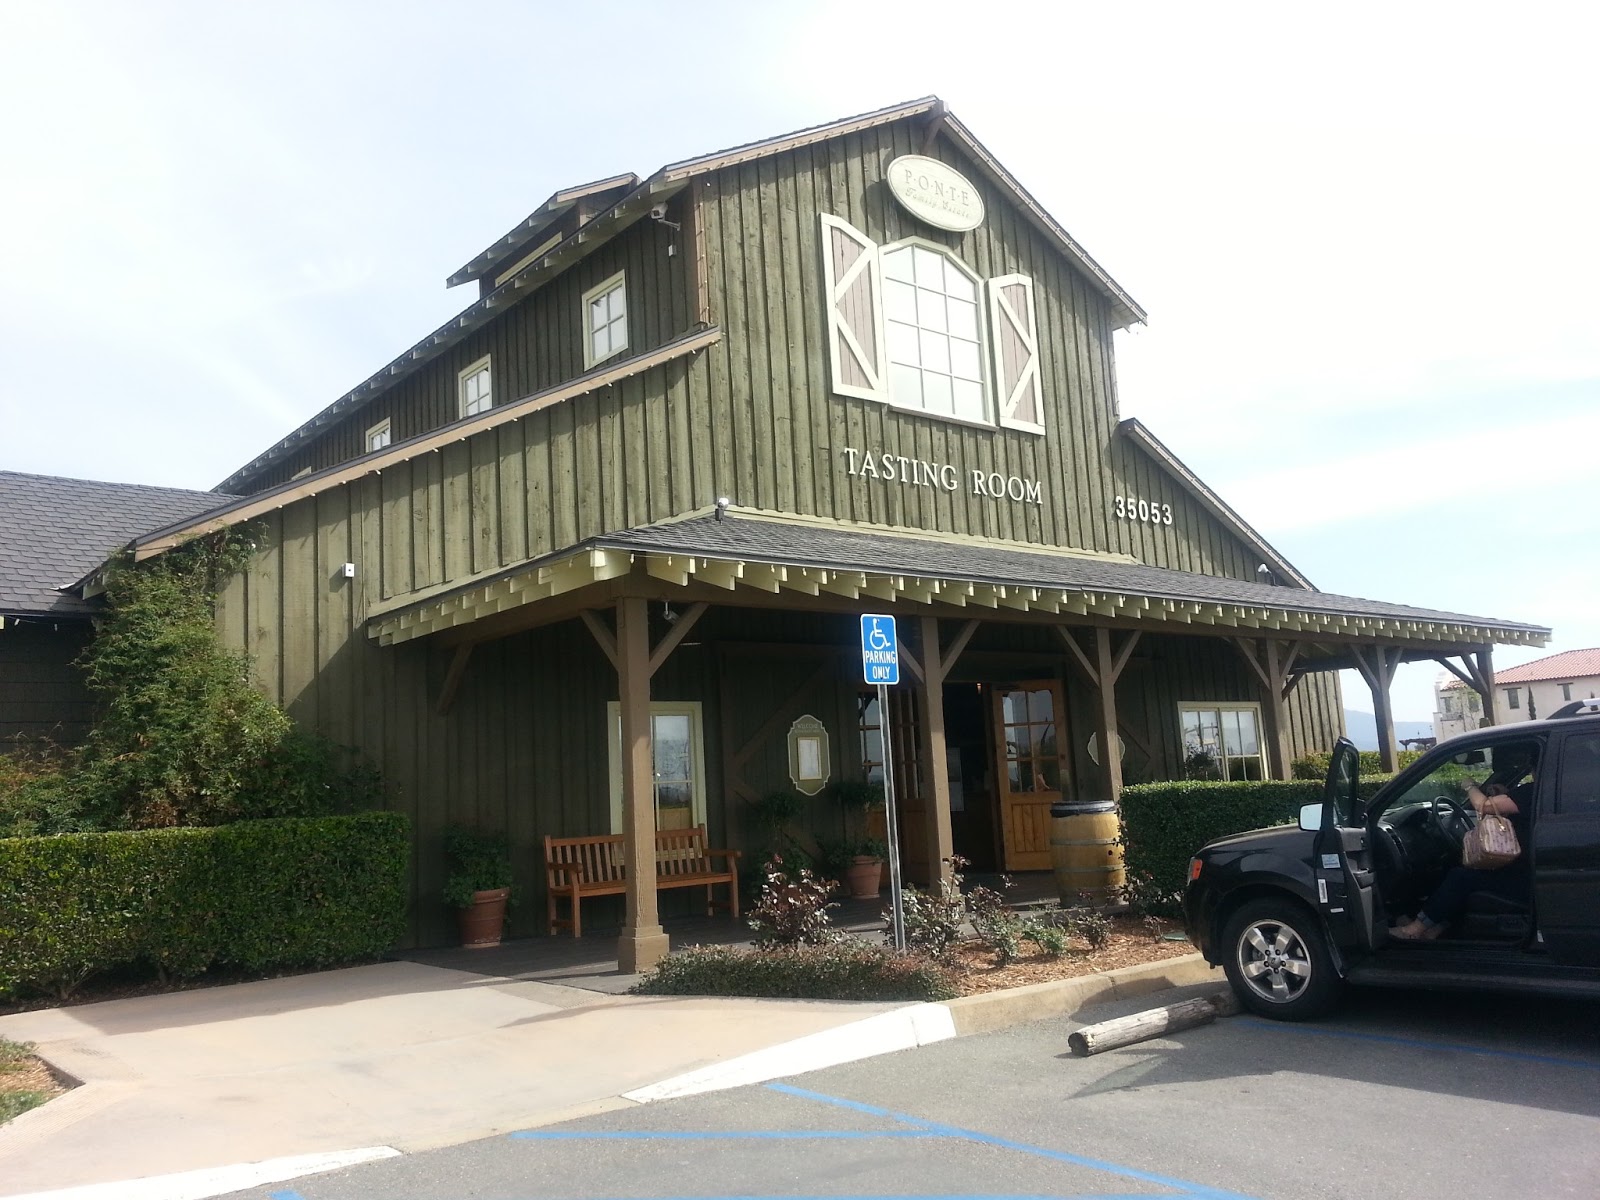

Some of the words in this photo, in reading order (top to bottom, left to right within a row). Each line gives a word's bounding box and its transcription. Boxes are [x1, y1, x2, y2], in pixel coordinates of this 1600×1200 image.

[844, 447, 958, 491] TASTING
[972, 469, 1044, 505] ROOM
[1115, 495, 1173, 525] 35053
[865, 650, 896, 664] PARKING
[872, 665, 891, 680] ONLY
